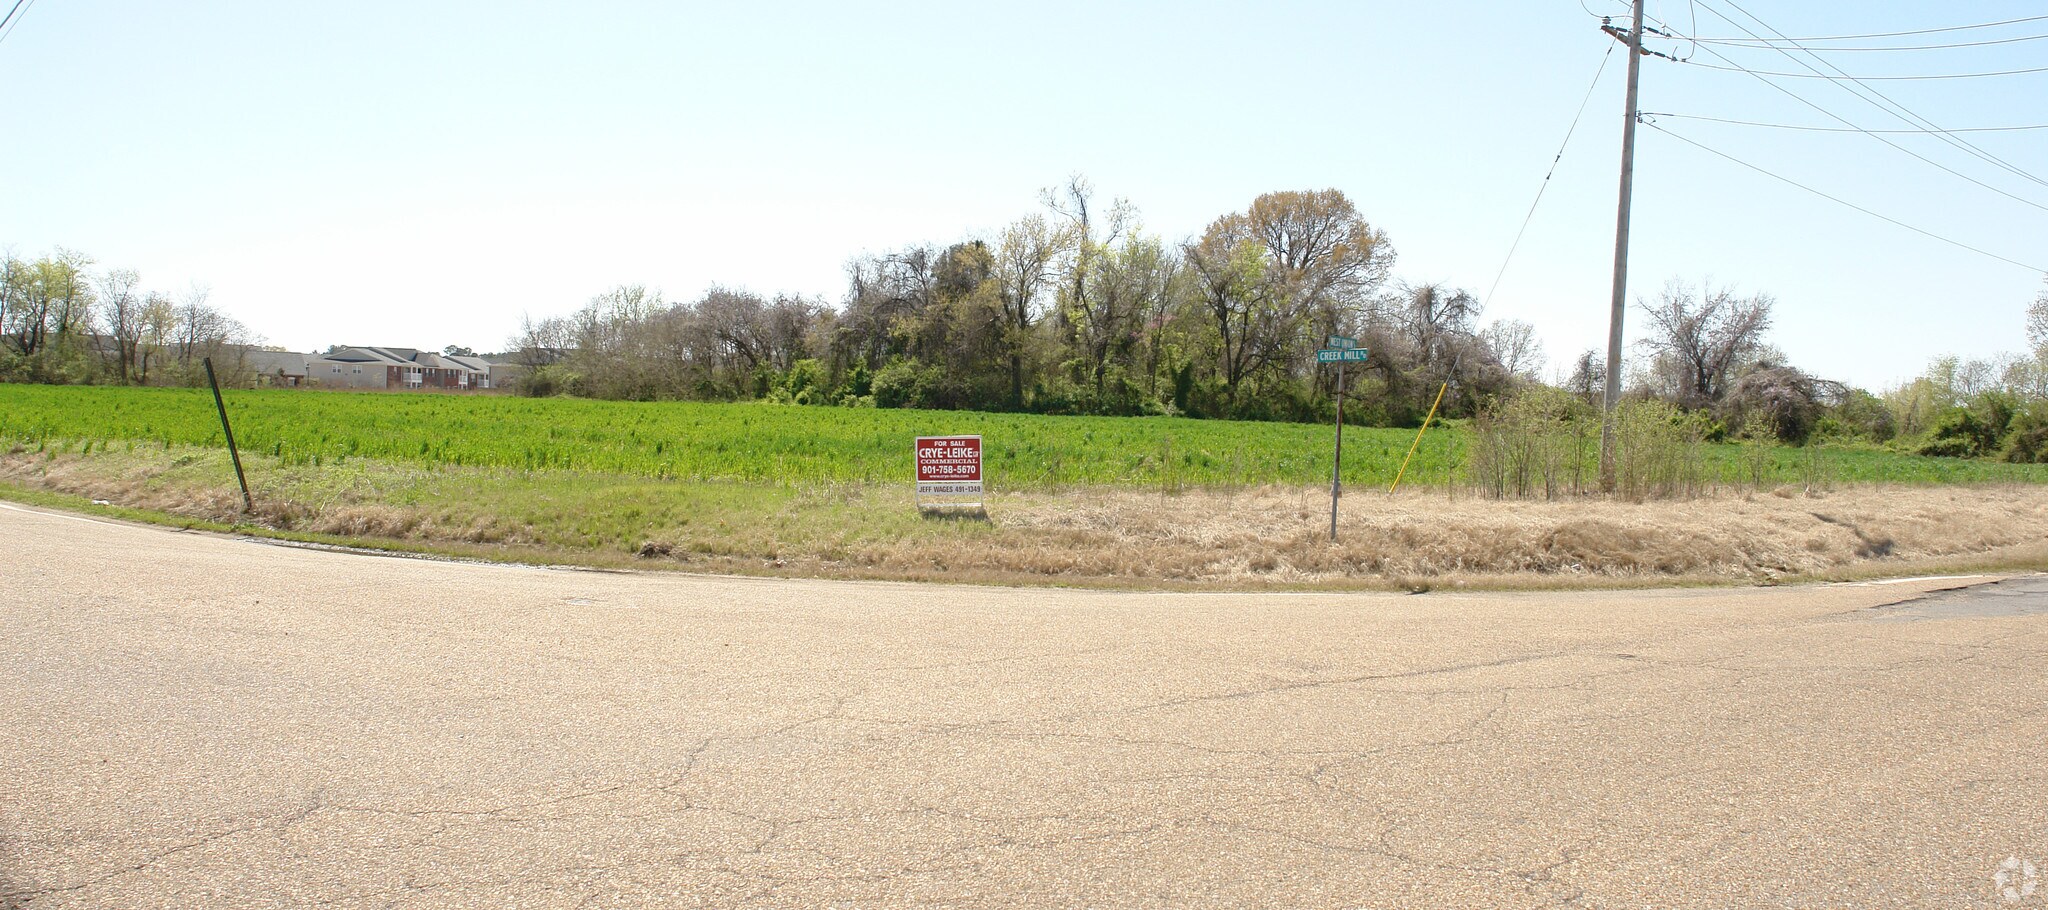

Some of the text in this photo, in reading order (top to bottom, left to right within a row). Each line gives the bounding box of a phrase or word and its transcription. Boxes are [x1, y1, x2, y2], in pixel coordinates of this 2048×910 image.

[1320, 352, 1342, 360] CREEK
[1344, 351, 1360, 360] MILL
[919, 448, 973, 458] CRYE-LEIKE
[922, 465, 976, 474] 901-758-5670
